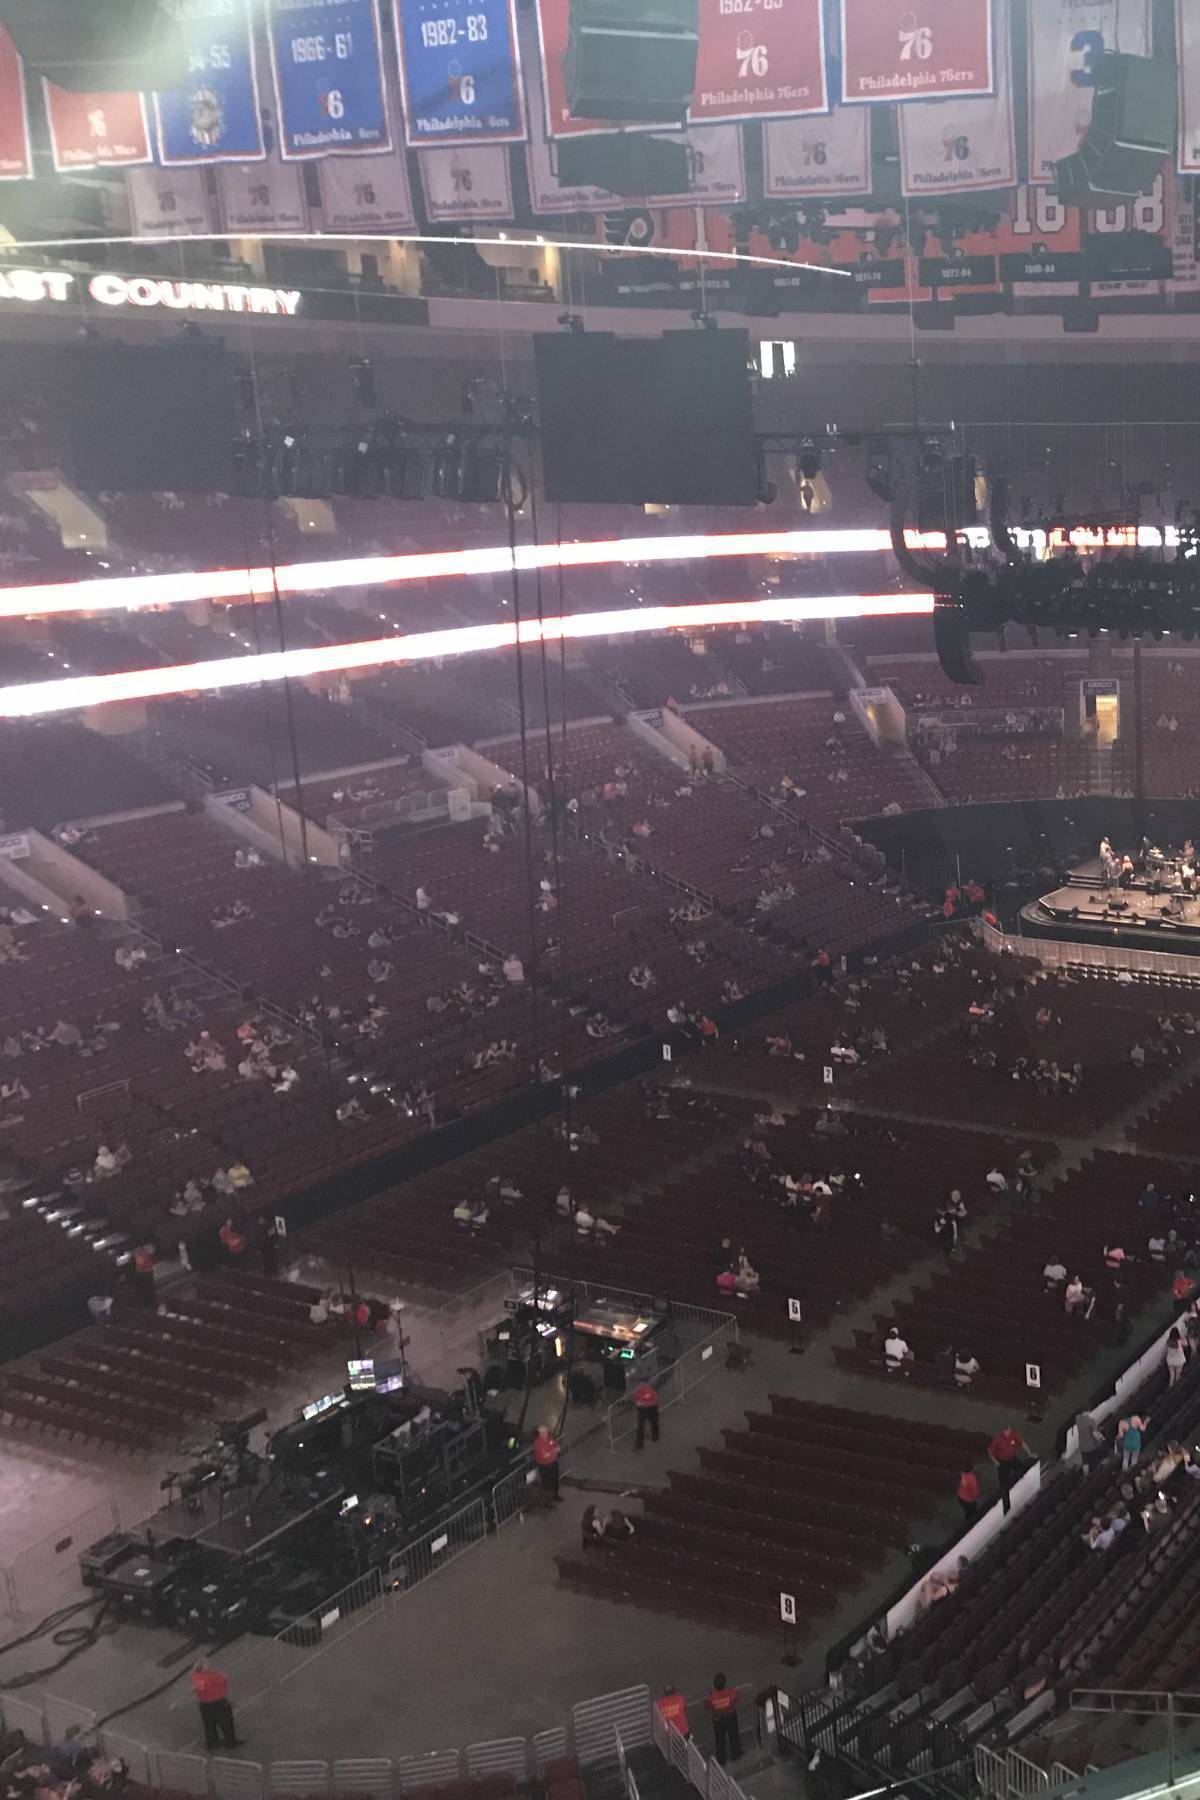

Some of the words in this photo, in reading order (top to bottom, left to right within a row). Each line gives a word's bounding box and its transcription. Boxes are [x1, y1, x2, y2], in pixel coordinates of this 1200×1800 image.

[420, 14, 488, 48] 1982-83
[898, 26, 934, 61] 76
[735, 44, 769, 78] 76
[1069, 29, 1104, 87] 3
[859, 71, 936, 91] Philadelphia
[939, 67, 975, 82] 76ers
[700, 89, 776, 107] Philadelphia
[776, 84, 809, 99] 76ers
[359, 127, 380, 140] 6ers
[415, 117, 483, 132] Philadelphia
[488, 116, 510, 128] 6ers
[800, 141, 827, 166] 76
[942, 135, 969, 162] 76
[775, 173, 830, 186] Philadelphia
[912, 170, 973, 185] Philadelphia
[1013, 183, 1066, 234] 16
[88, 275, 300, 316] COUNTRY
[791, 1300, 798, 1315] 5
[1029, 1366, 1037, 1381] 6
